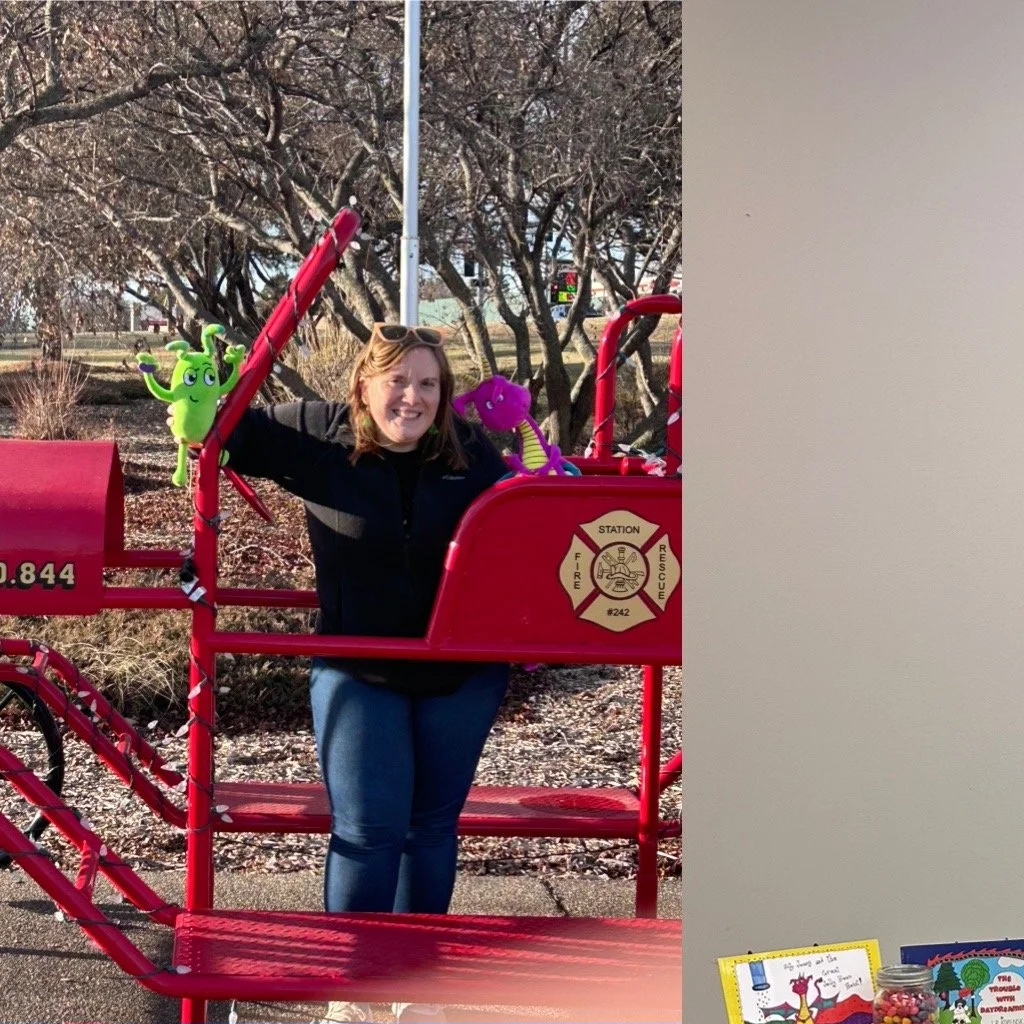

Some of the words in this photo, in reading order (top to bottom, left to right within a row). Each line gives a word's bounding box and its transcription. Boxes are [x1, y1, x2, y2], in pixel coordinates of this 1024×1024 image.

[598, 525, 640, 534] STATION
[573, 552, 582, 590] FIRE
[658, 544, 667, 600] RESCUE
[606, 608, 631, 617] #242
